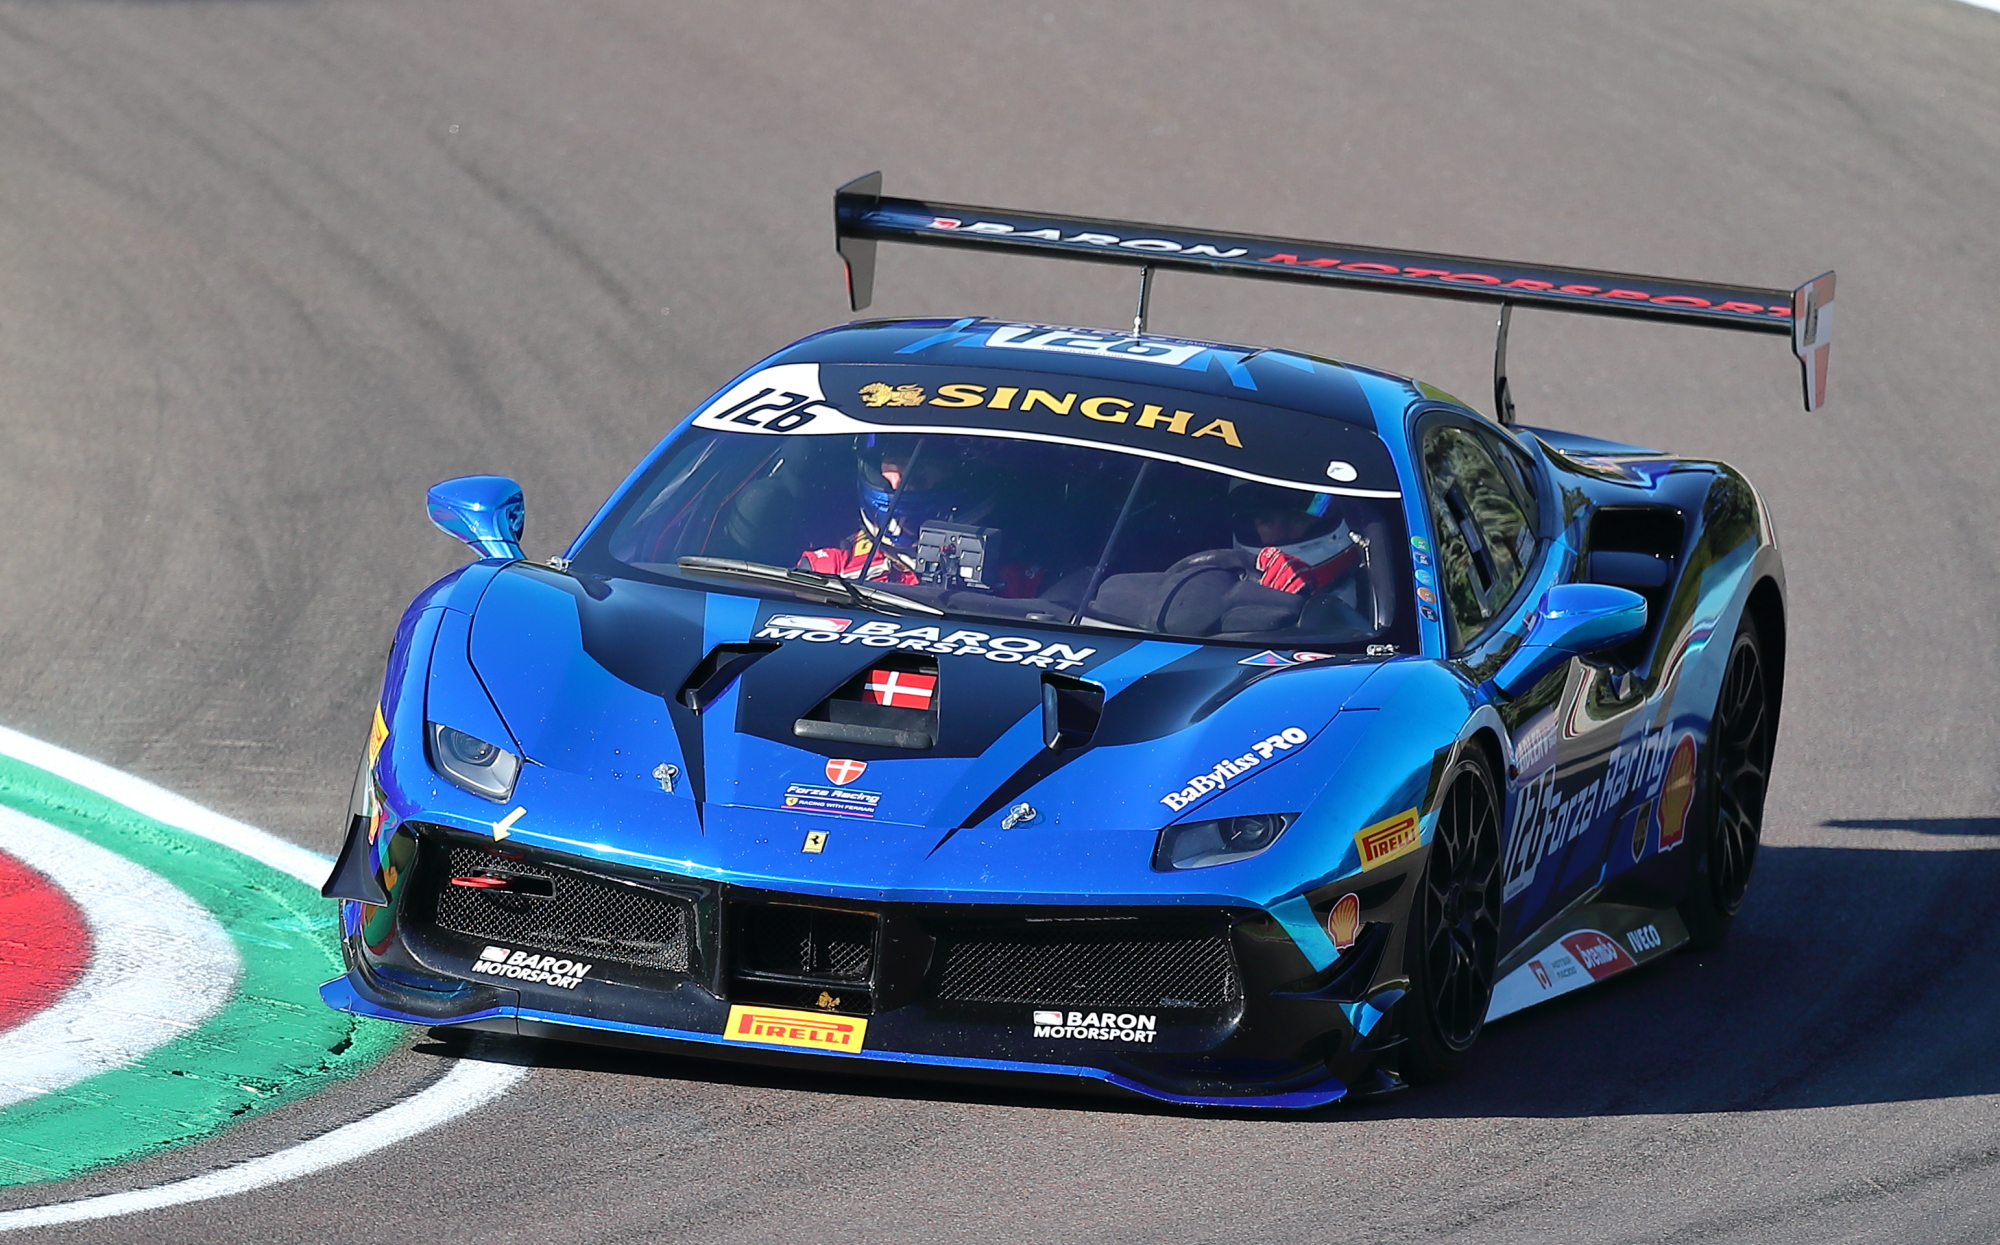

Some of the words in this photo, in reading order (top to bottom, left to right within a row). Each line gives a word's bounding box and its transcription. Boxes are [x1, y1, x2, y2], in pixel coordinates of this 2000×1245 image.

[960, 221, 1248, 258] BARON
[1002, 328, 1188, 357] 126
[714, 388, 834, 432] 126
[927, 382, 1244, 449] SINGHA
[754, 627, 1086, 671] MOTORSPORT
[851, 620, 1097, 662] BARON
[1160, 752, 1261, 812] BaByliss
[1251, 726, 1308, 760] PRO
[1596, 718, 1674, 820] Racing
[786, 785, 830, 797] Forza
[830, 789, 881, 803] Racing
[798, 799, 826, 807] RACING
[844, 804, 875, 813] FERRARI
[1362, 816, 1417, 862] PIRELLI
[1575, 937, 1619, 970] brembo
[1626, 924, 1662, 954] IVECO
[471, 960, 583, 990] MOTORSPORT
[506, 950, 592, 978] BARON
[738, 1013, 855, 1045] PIRELLI
[1033, 1025, 1157, 1043] MOTORSPORT
[1066, 1011, 1157, 1031] BARON
